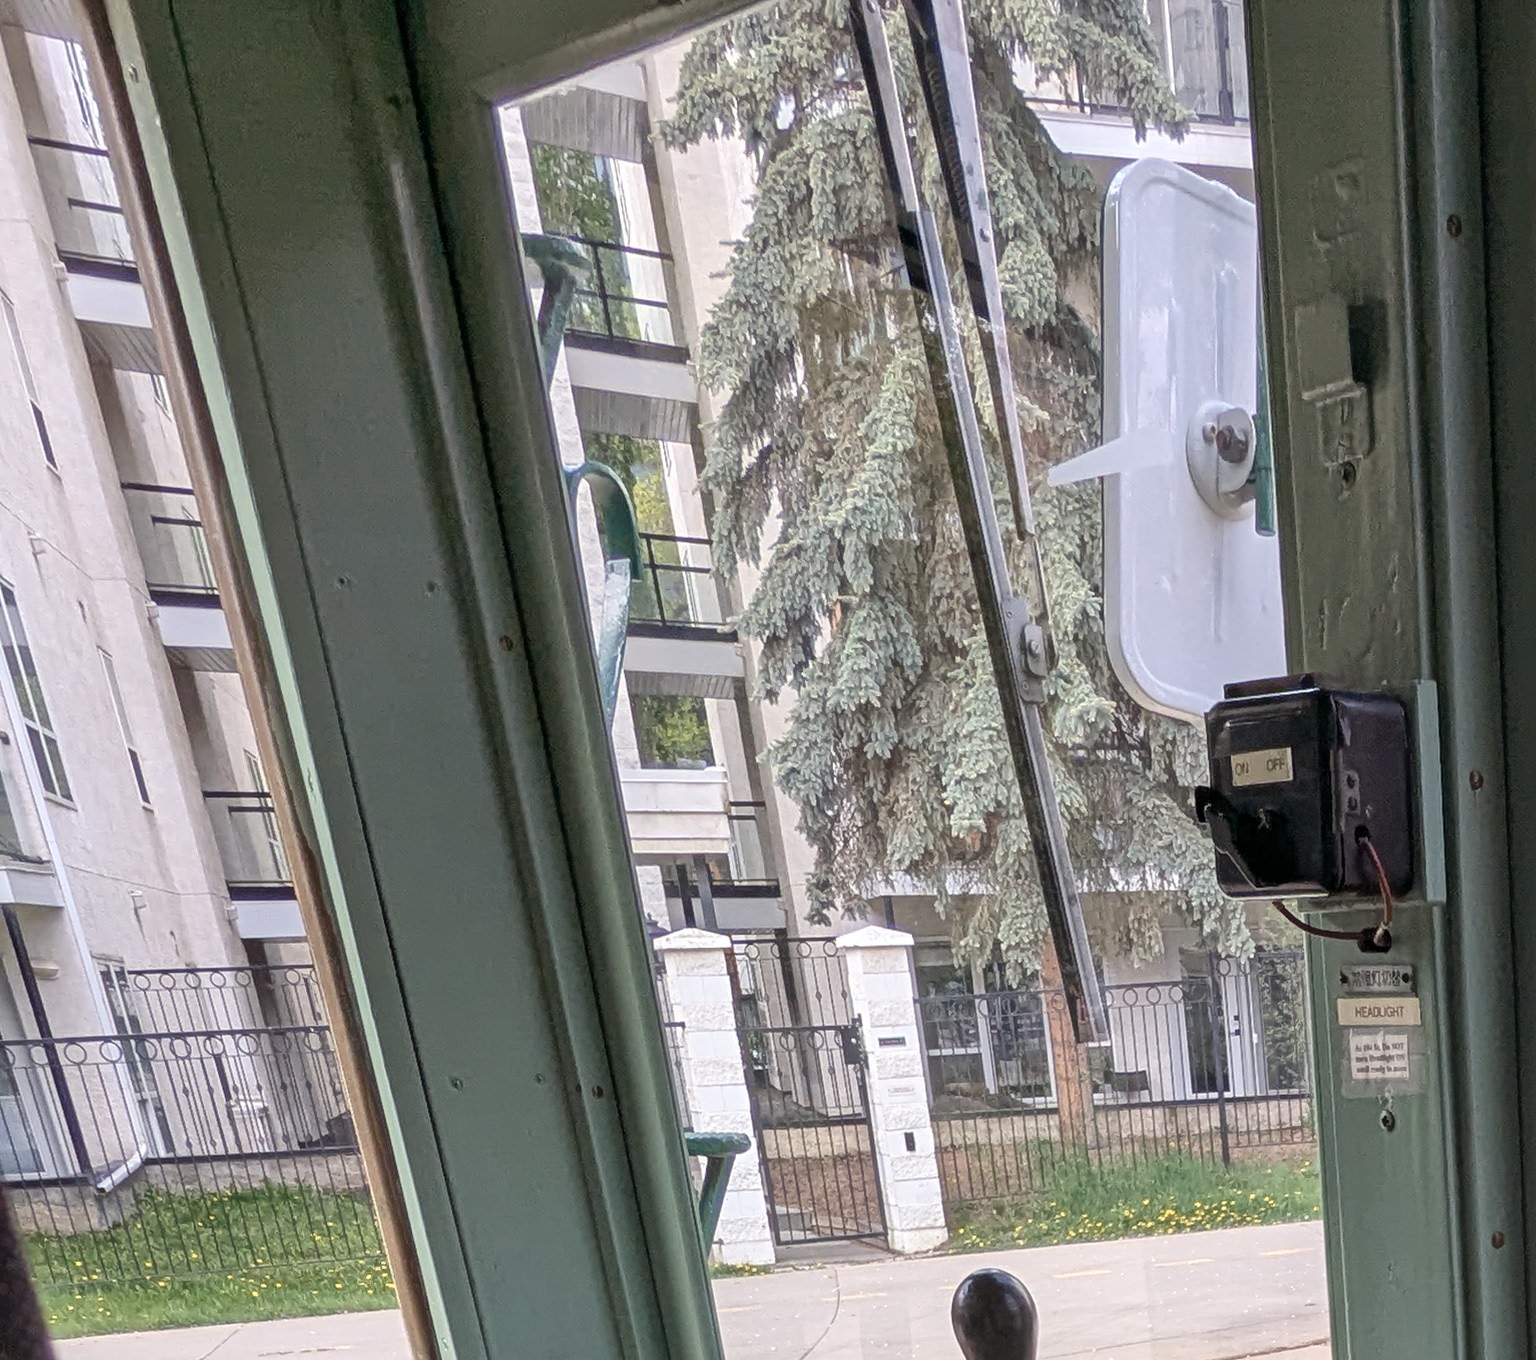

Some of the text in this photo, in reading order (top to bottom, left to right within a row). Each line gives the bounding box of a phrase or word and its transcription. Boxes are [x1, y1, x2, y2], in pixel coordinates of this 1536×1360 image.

[1234, 761, 1250, 776] ON
[1265, 757, 1286, 773] OFF
[1354, 1005, 1405, 1018] HEADLIGHT
